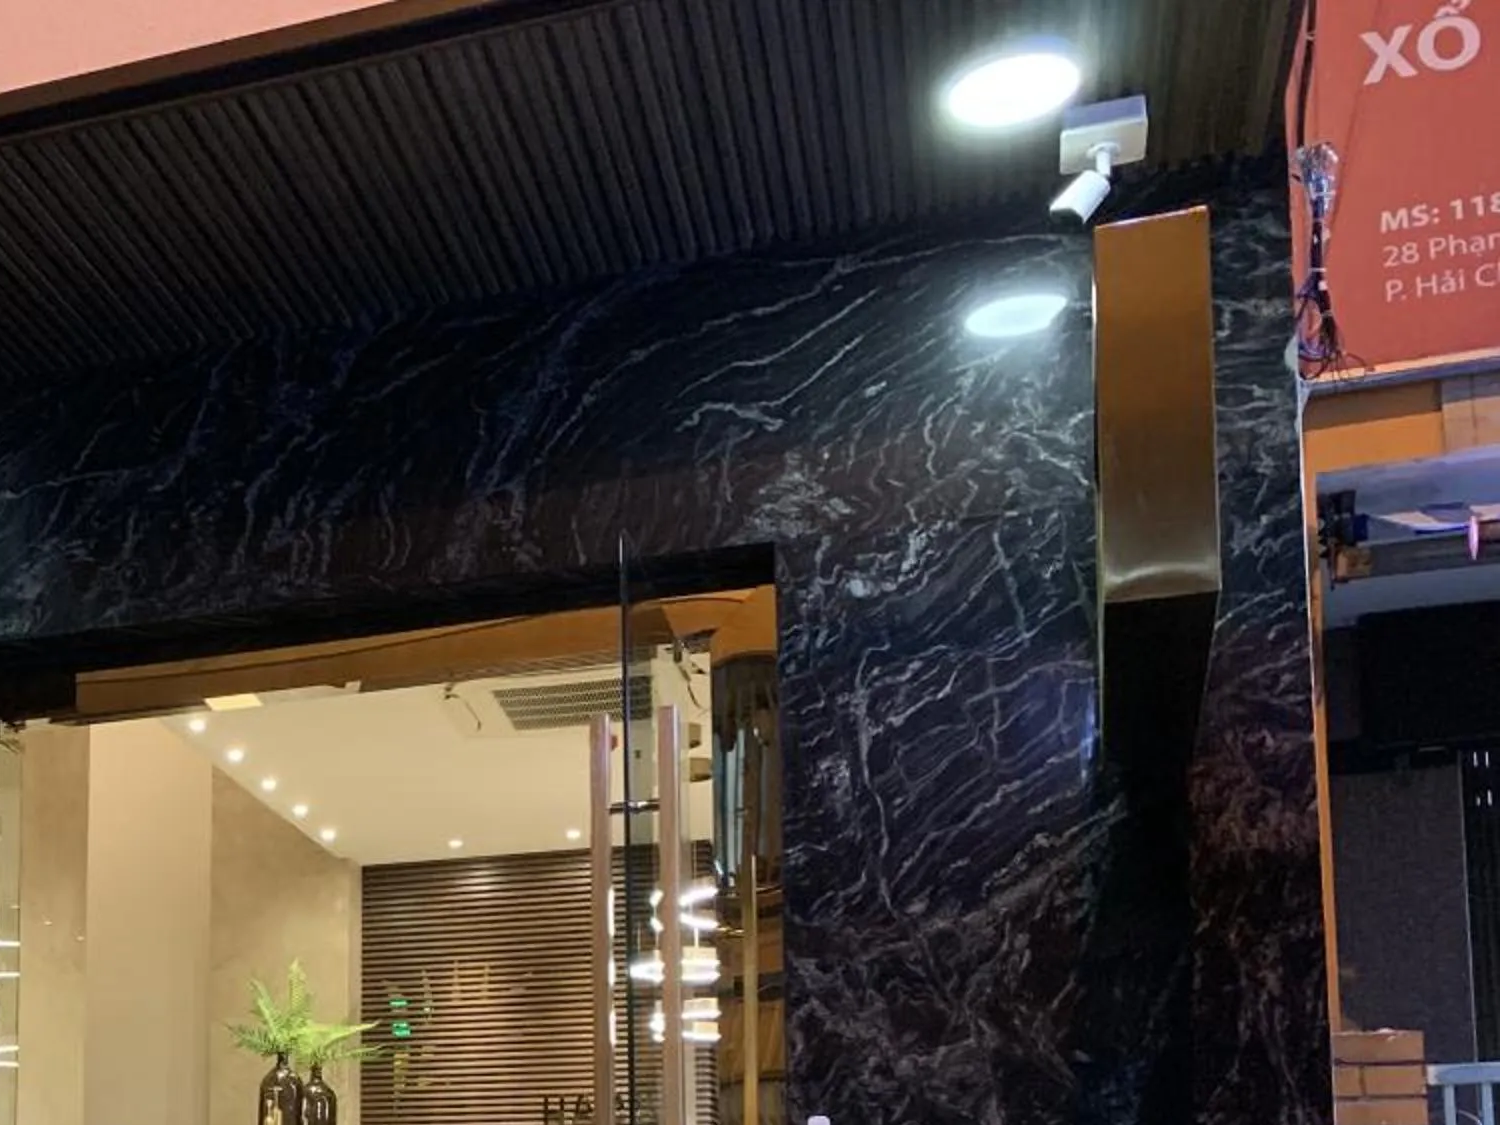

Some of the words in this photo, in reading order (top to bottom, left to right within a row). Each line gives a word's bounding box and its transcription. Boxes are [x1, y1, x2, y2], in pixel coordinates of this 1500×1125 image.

[1359, 0, 1481, 86] XỔ
[1380, 203, 1440, 234] MS:
[1383, 242, 1420, 268] 28
[1385, 279, 1407, 302] P.
[1416, 269, 1465, 298] Hải
